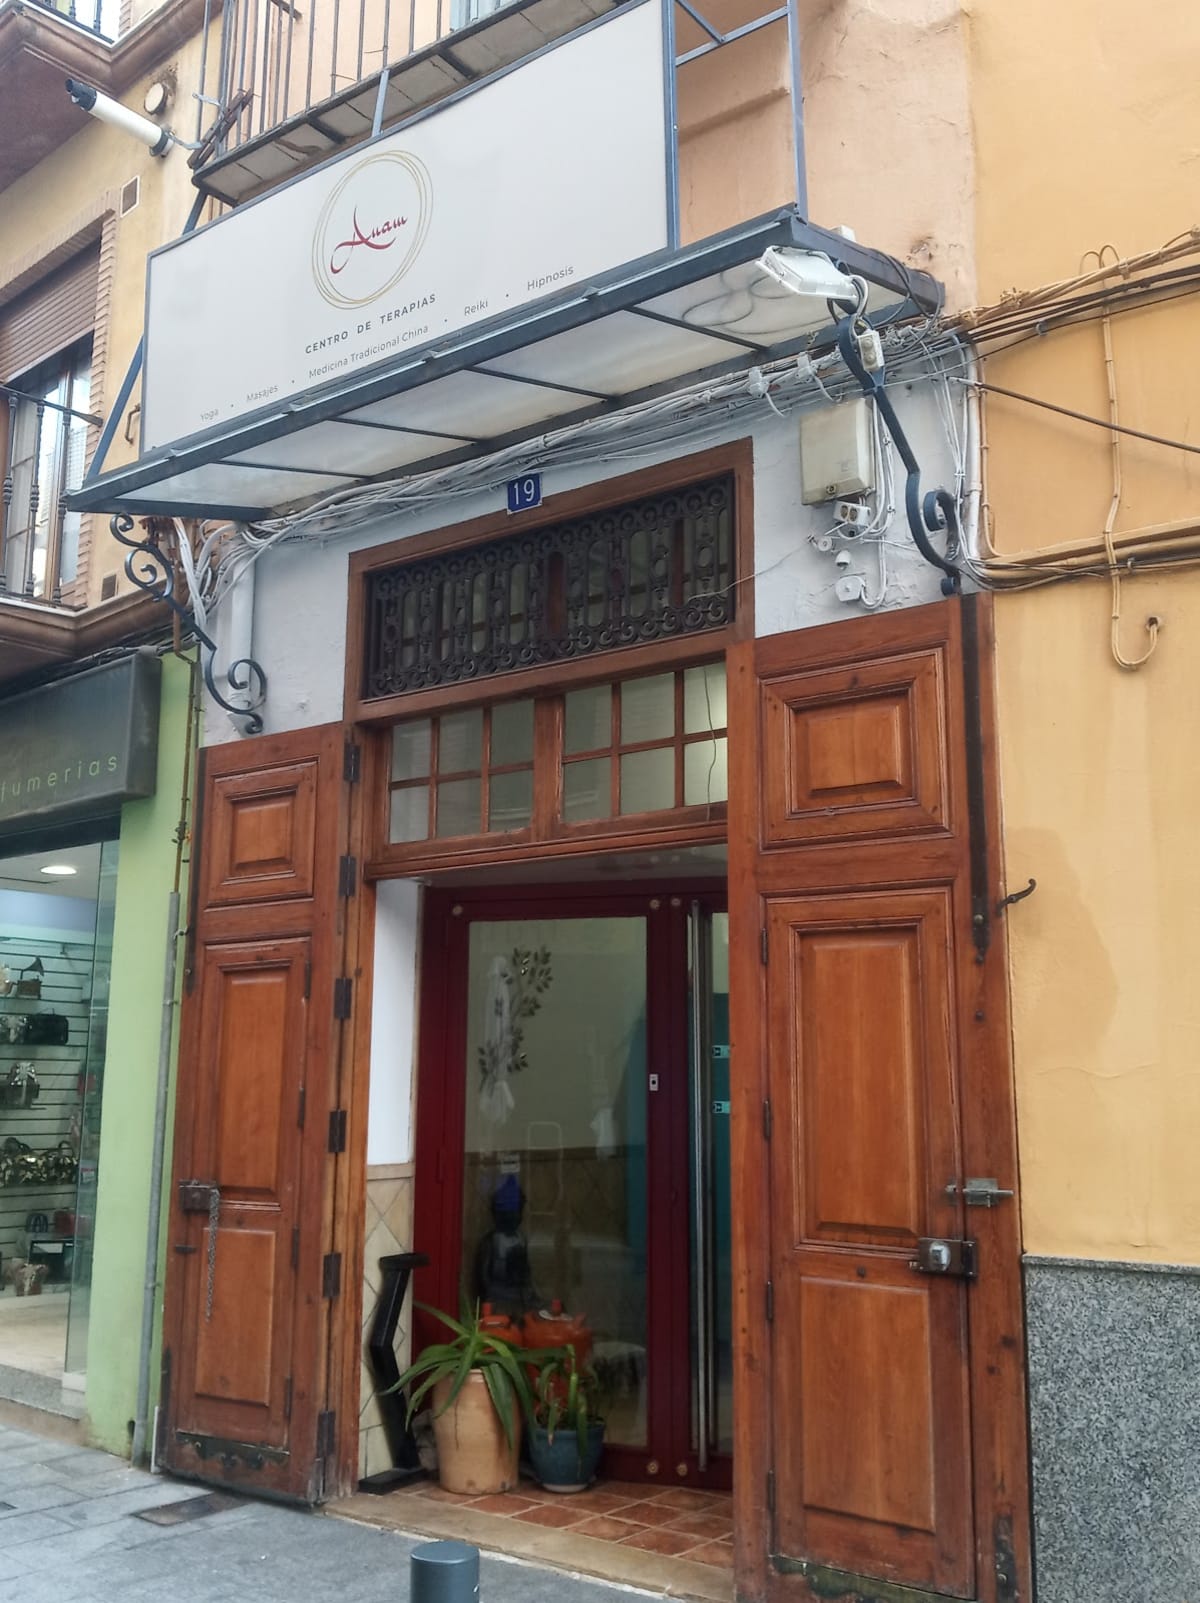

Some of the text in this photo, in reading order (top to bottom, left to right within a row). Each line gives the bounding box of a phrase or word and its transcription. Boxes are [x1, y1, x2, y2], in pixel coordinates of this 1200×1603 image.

[200, 266, 575, 423] Yoga Masajes Medicina Tradicional China Reiki Hipnosis
[305, 293, 436, 354] CENTRO DE TERAPIAS
[514, 479, 535, 505] 19
